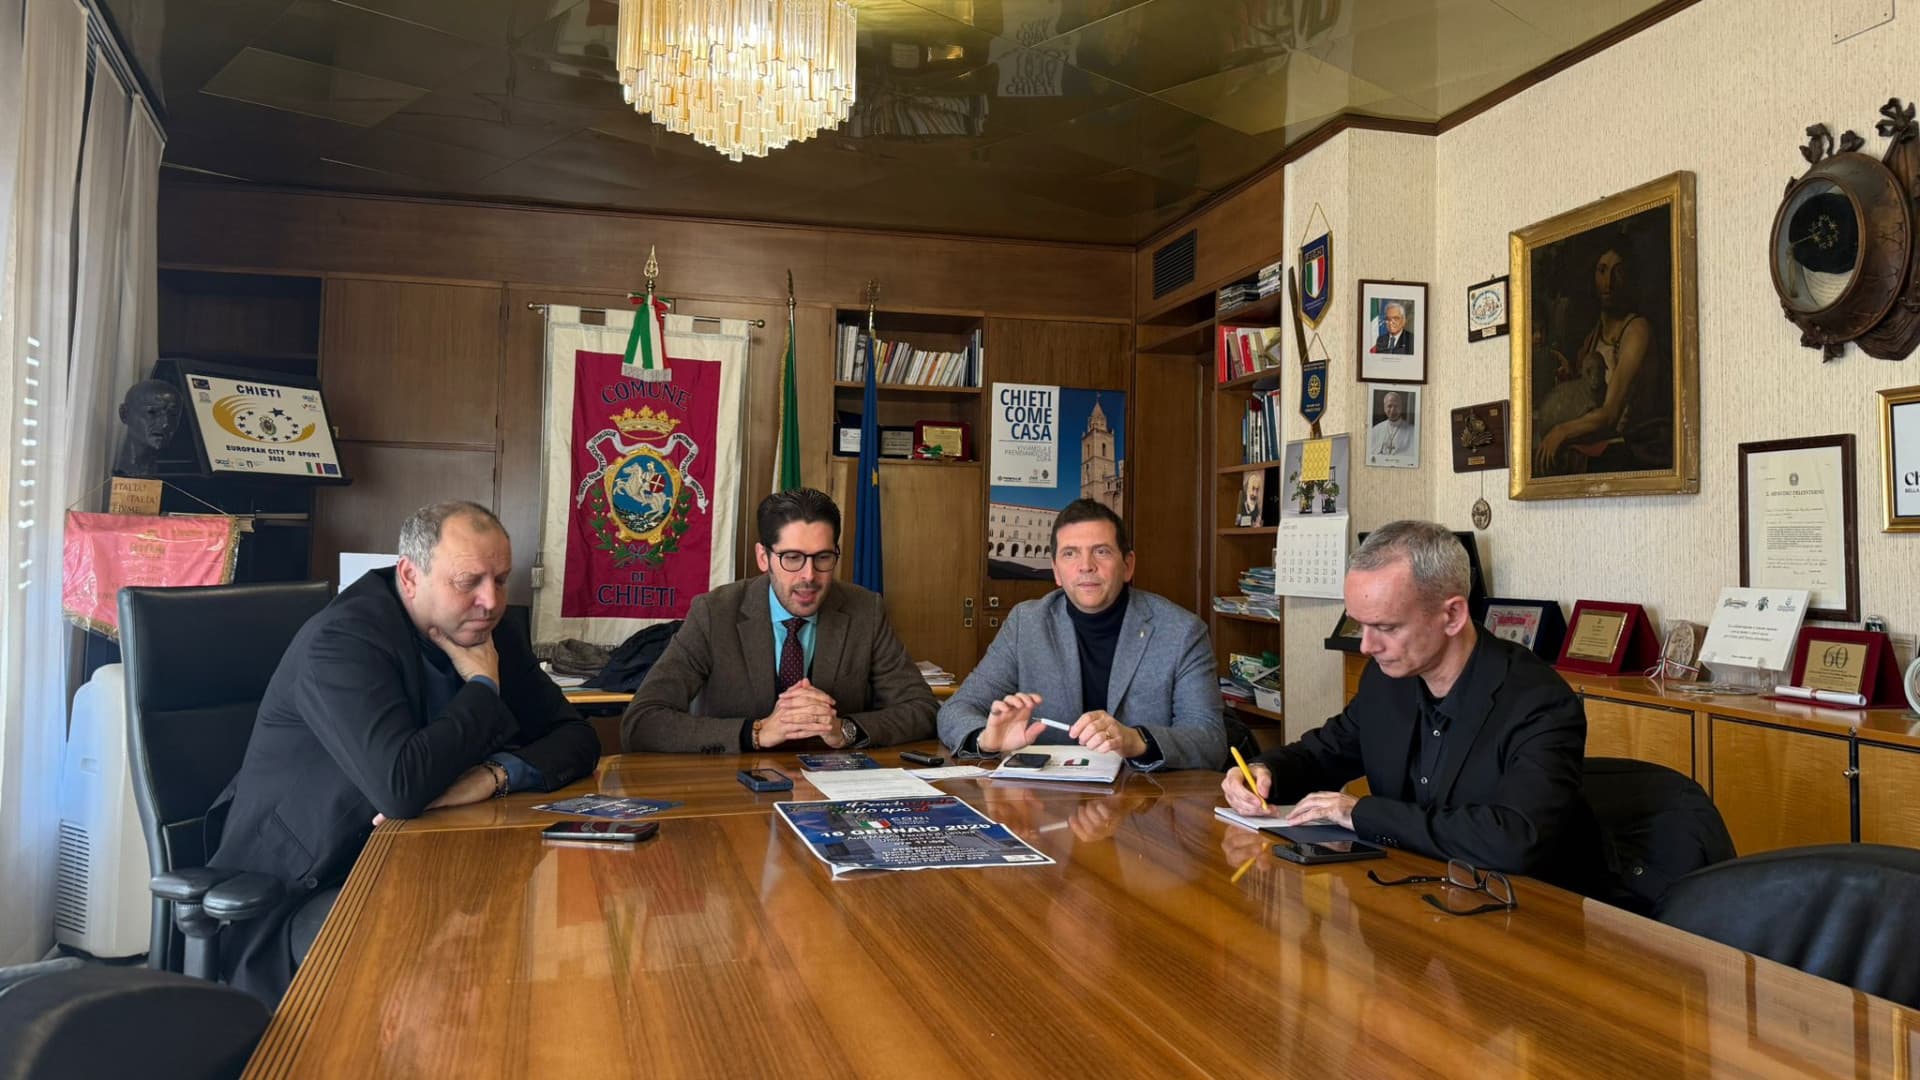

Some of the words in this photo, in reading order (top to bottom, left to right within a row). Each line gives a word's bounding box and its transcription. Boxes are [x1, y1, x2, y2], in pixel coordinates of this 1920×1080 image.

[237, 384, 281, 398] CHIETI
[602, 380, 689, 411] COMUNE
[1000, 388, 1052, 407] CHIETI
[1005, 406, 1052, 424] COME
[1011, 423, 1052, 441] CASA
[226, 445, 266, 454] EUROPEAN
[631, 571, 644, 582] DI
[598, 584, 676, 607] CHIETI
[1823, 644, 1849, 669] 60
[850, 826, 940, 836] GENNAIO
